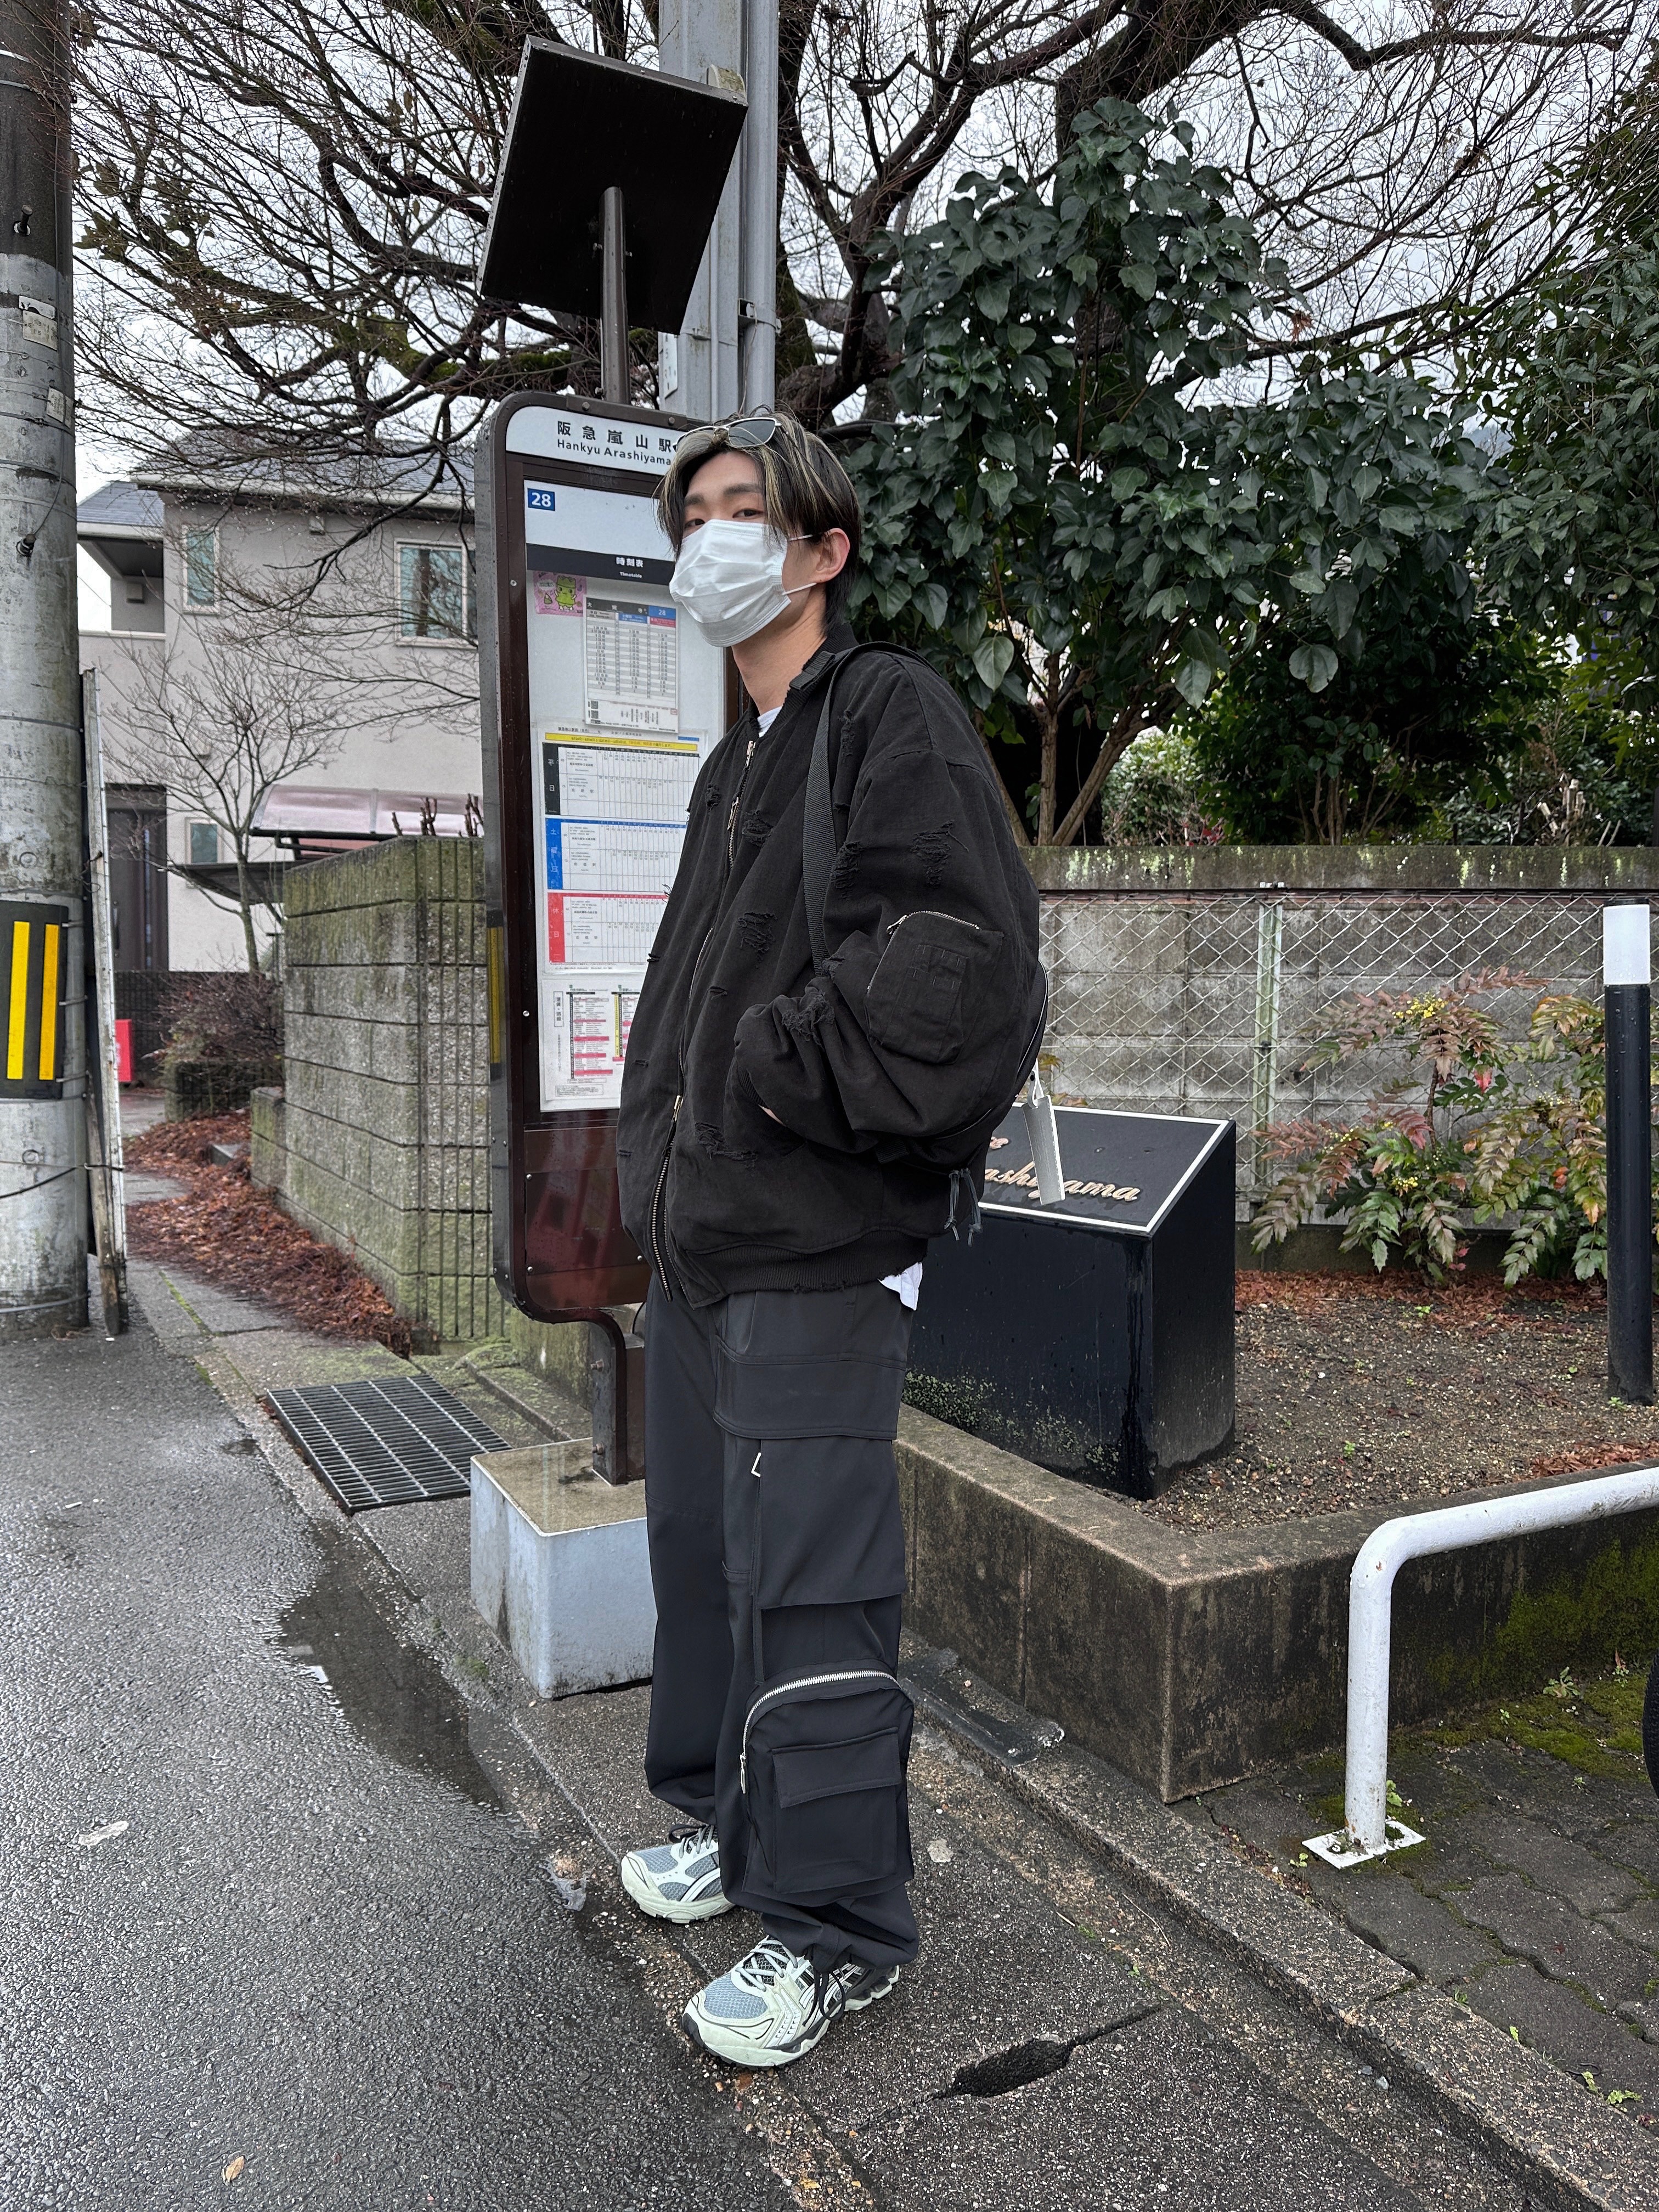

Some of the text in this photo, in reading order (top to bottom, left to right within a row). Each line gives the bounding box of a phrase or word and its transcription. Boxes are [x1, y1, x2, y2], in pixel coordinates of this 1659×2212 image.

[557, 420, 672, 453] 阪急嵐山駅
[557, 438, 671, 465] Hankyu Arashiyama
[531, 492, 551, 507] 28
[616, 557, 643, 567] 時刻表
